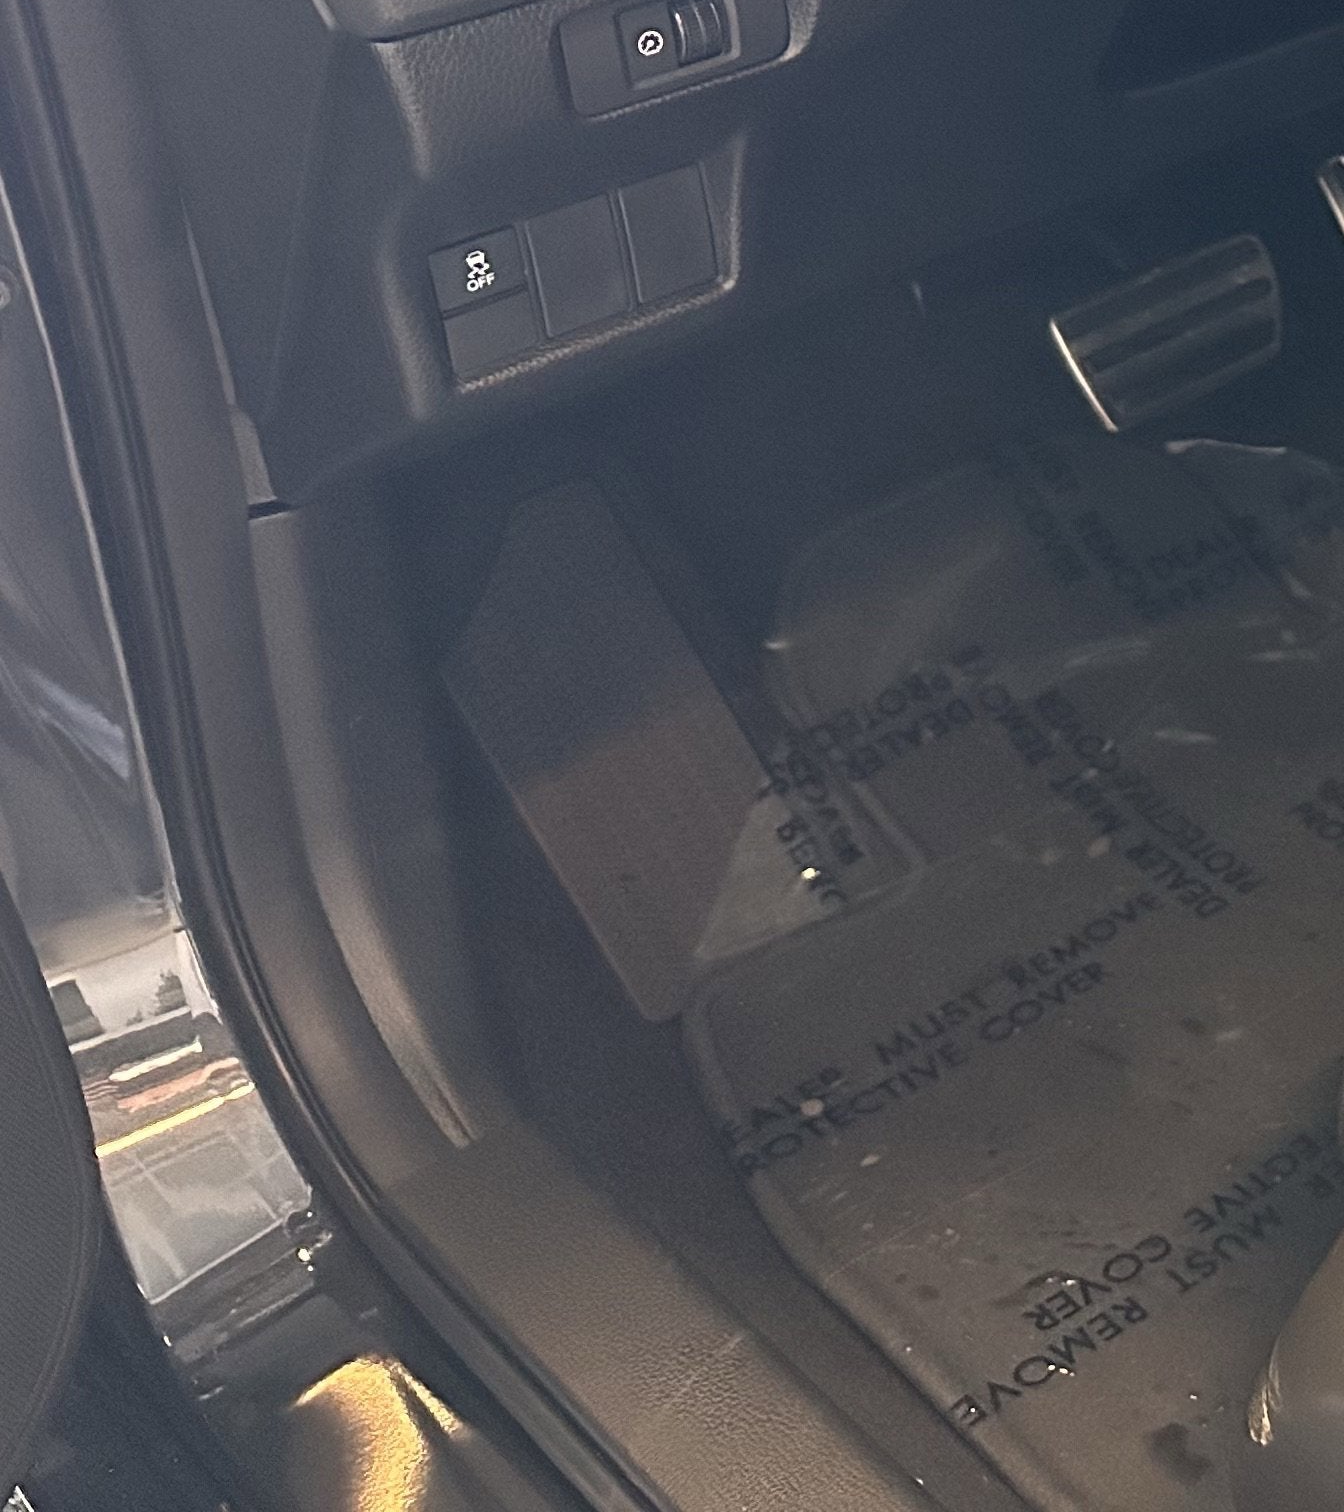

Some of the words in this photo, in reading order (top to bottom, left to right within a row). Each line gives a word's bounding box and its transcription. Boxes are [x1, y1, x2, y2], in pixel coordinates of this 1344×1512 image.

[466, 272, 496, 292] OFF
[1125, 840, 1230, 919] DEALER
[875, 992, 990, 1065] MUST
[1005, 893, 1161, 990] REMOVE
[739, 1043, 967, 1173] ROTECTIVE
[981, 961, 1114, 1042] COVER
[1022, 1235, 1173, 1331] COVER
[1166, 1206, 1283, 1295] MUST
[952, 1296, 1149, 1426] REMOVE
